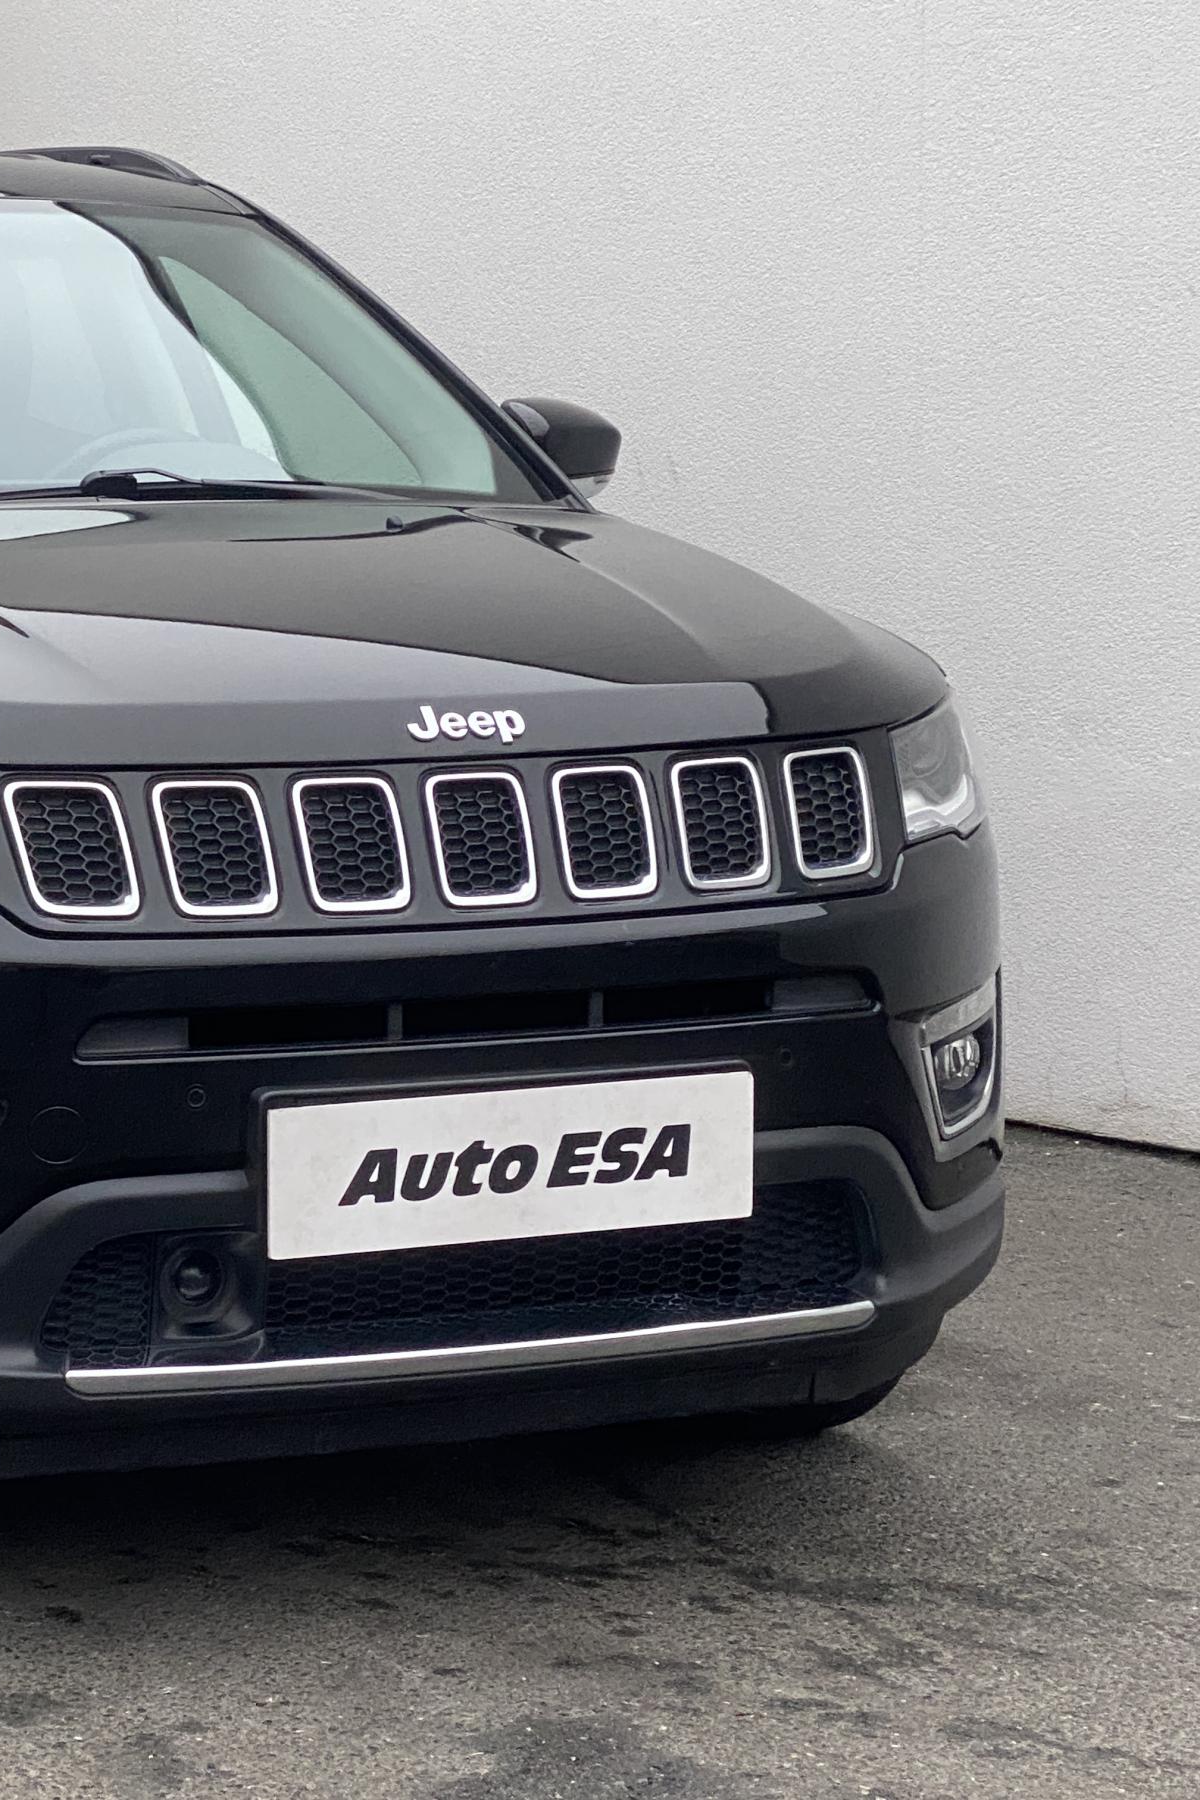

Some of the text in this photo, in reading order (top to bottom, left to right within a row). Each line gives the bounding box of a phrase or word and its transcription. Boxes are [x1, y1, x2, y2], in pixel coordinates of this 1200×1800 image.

[406, 705, 526, 744] Jeep
[338, 1123, 691, 1206] Auto ESA
